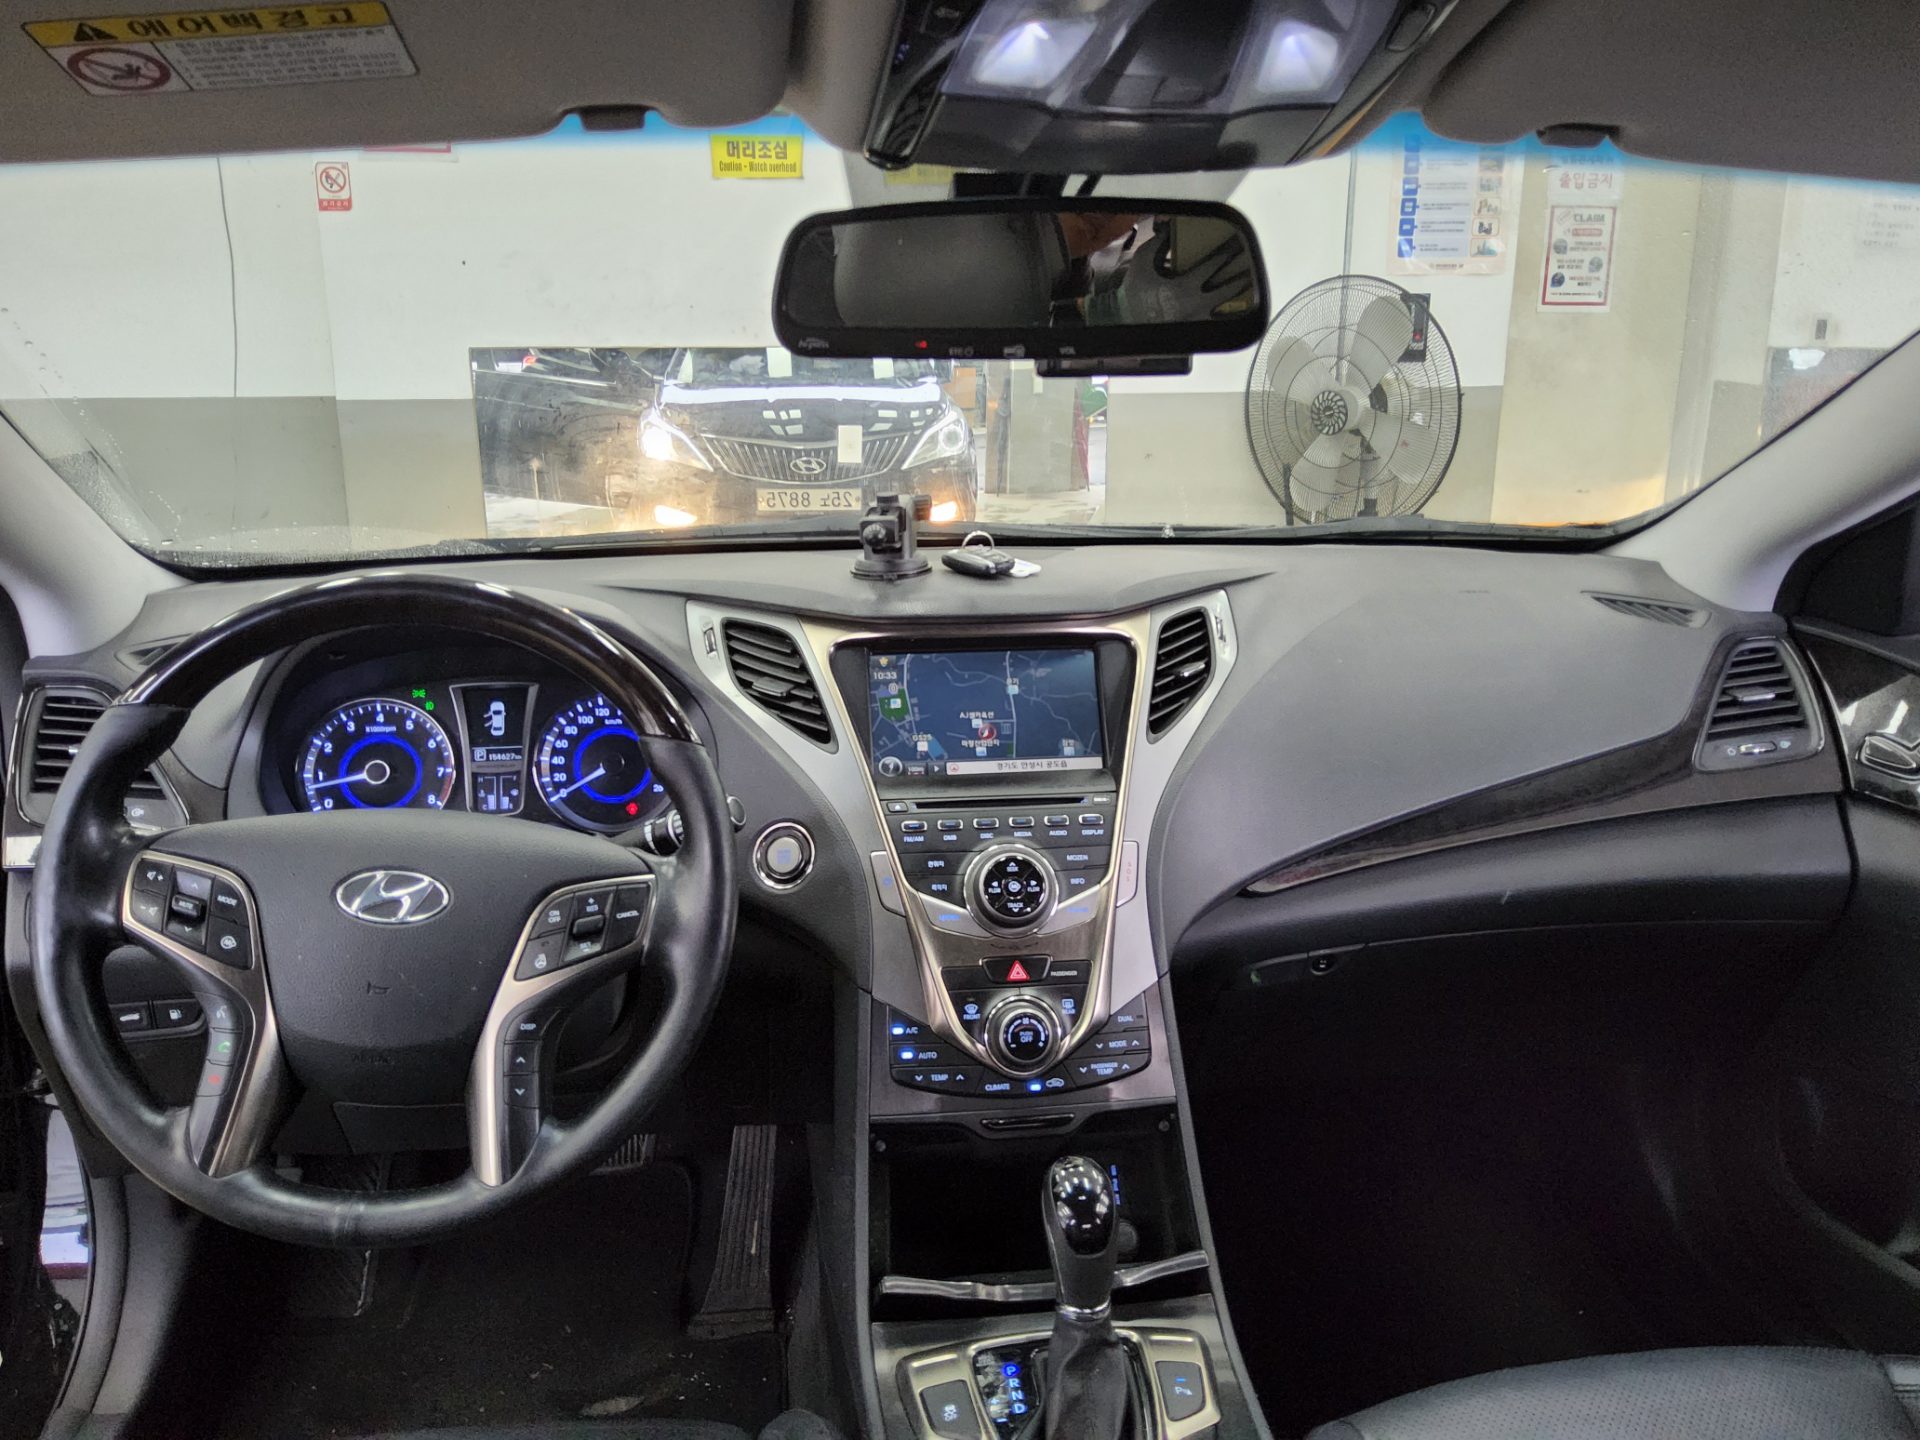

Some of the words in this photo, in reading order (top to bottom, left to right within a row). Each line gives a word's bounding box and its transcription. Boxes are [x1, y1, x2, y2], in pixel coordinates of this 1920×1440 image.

[127, 11, 263, 37] 에어백
[269, 7, 355, 28] 경고
[727, 140, 788, 160] 머리조심
[719, 161, 742, 172] Caution
[749, 162, 768, 172] Watch
[769, 162, 797, 173] overhead
[873, 671, 897, 680] 10:33
[594, 708, 610, 716] 120
[376, 713, 384, 723] 4
[578, 715, 594, 724] 100
[346, 721, 355, 732] 3
[406, 719, 414, 730] 5
[564, 726, 578, 735] 80
[323, 742, 333, 753] 2
[427, 738, 437, 749] 6
[554, 740, 568, 748] 60
[551, 756, 566, 765] 40
[997, 762, 1018, 770] 경기도
[1021, 761, 1043, 769] 안성시
[317, 769, 324, 781] 1
[436, 766, 446, 777] 7
[553, 773, 567, 781] 20
[323, 799, 334, 809] 0
[427, 794, 436, 805] 8
[548, 915, 562, 924] OFF
[615, 909, 640, 920] CANCEL
[963, 1013, 981, 1021] FRONT
[905, 1026, 919, 1035] A/C
[1020, 1035, 1034, 1043] OFF
[1108, 1040, 1128, 1049] MODE
[918, 1051, 938, 1060] AUTO
[1096, 1068, 1114, 1076] TEMP
[931, 1073, 949, 1082] TEMP
[984, 1082, 1011, 1092] CLIMATE
[1005, 1365, 1017, 1376] P
[1008, 1378, 1020, 1388] R
[1011, 1390, 1023, 1401] N
[1014, 1403, 1026, 1414] D
